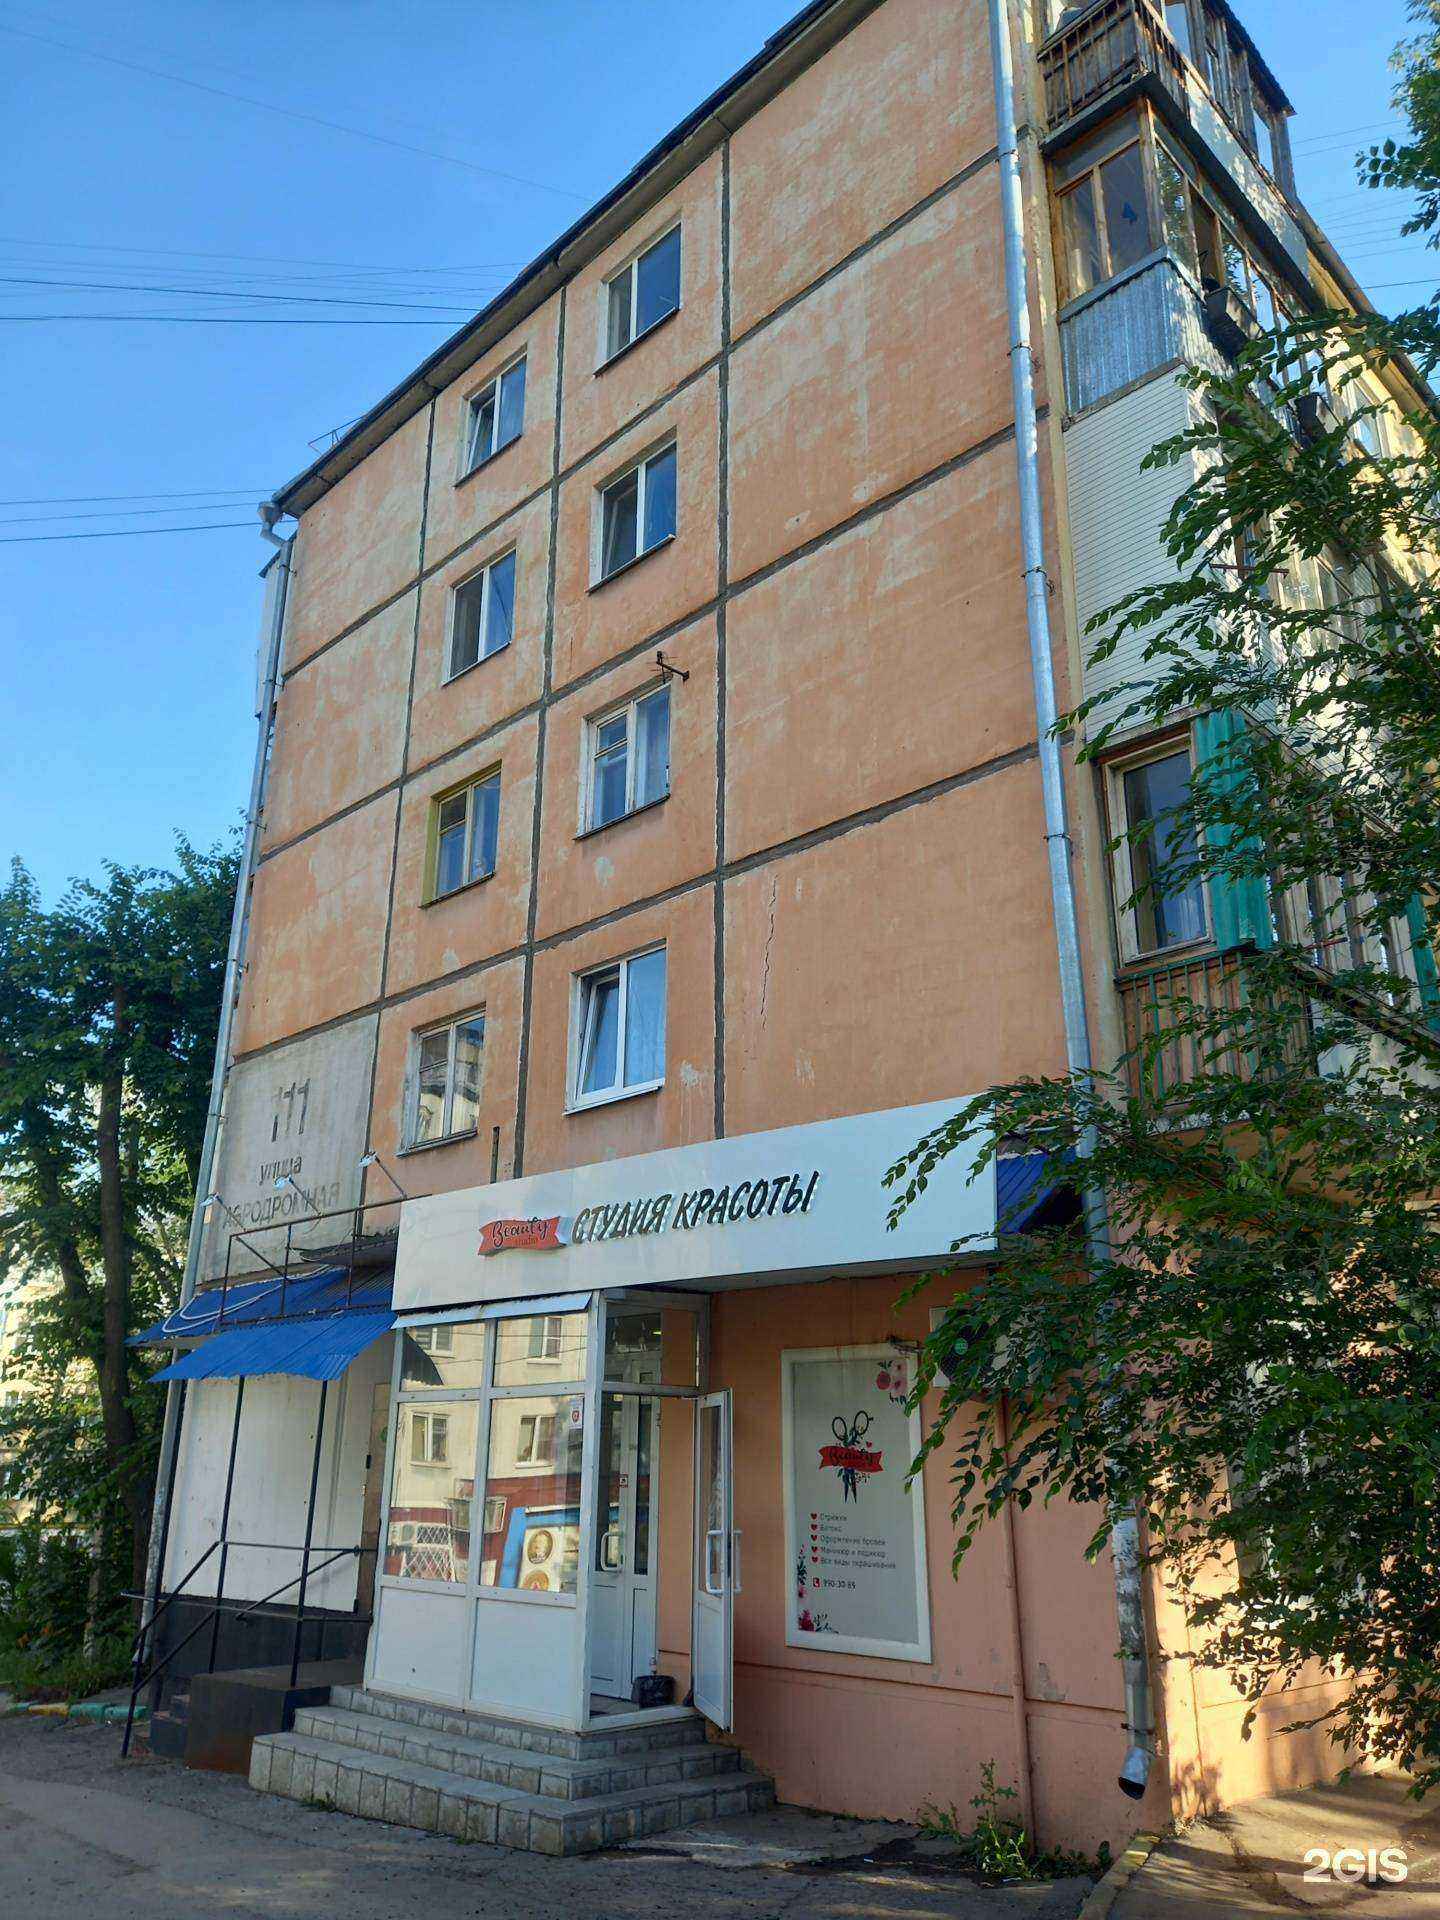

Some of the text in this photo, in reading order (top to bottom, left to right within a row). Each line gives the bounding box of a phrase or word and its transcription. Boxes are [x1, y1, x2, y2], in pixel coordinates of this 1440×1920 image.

[492, 1216, 547, 1248] Beauty
[571, 1170, 820, 1246] СТУДИЯ КРАСОТЫ
